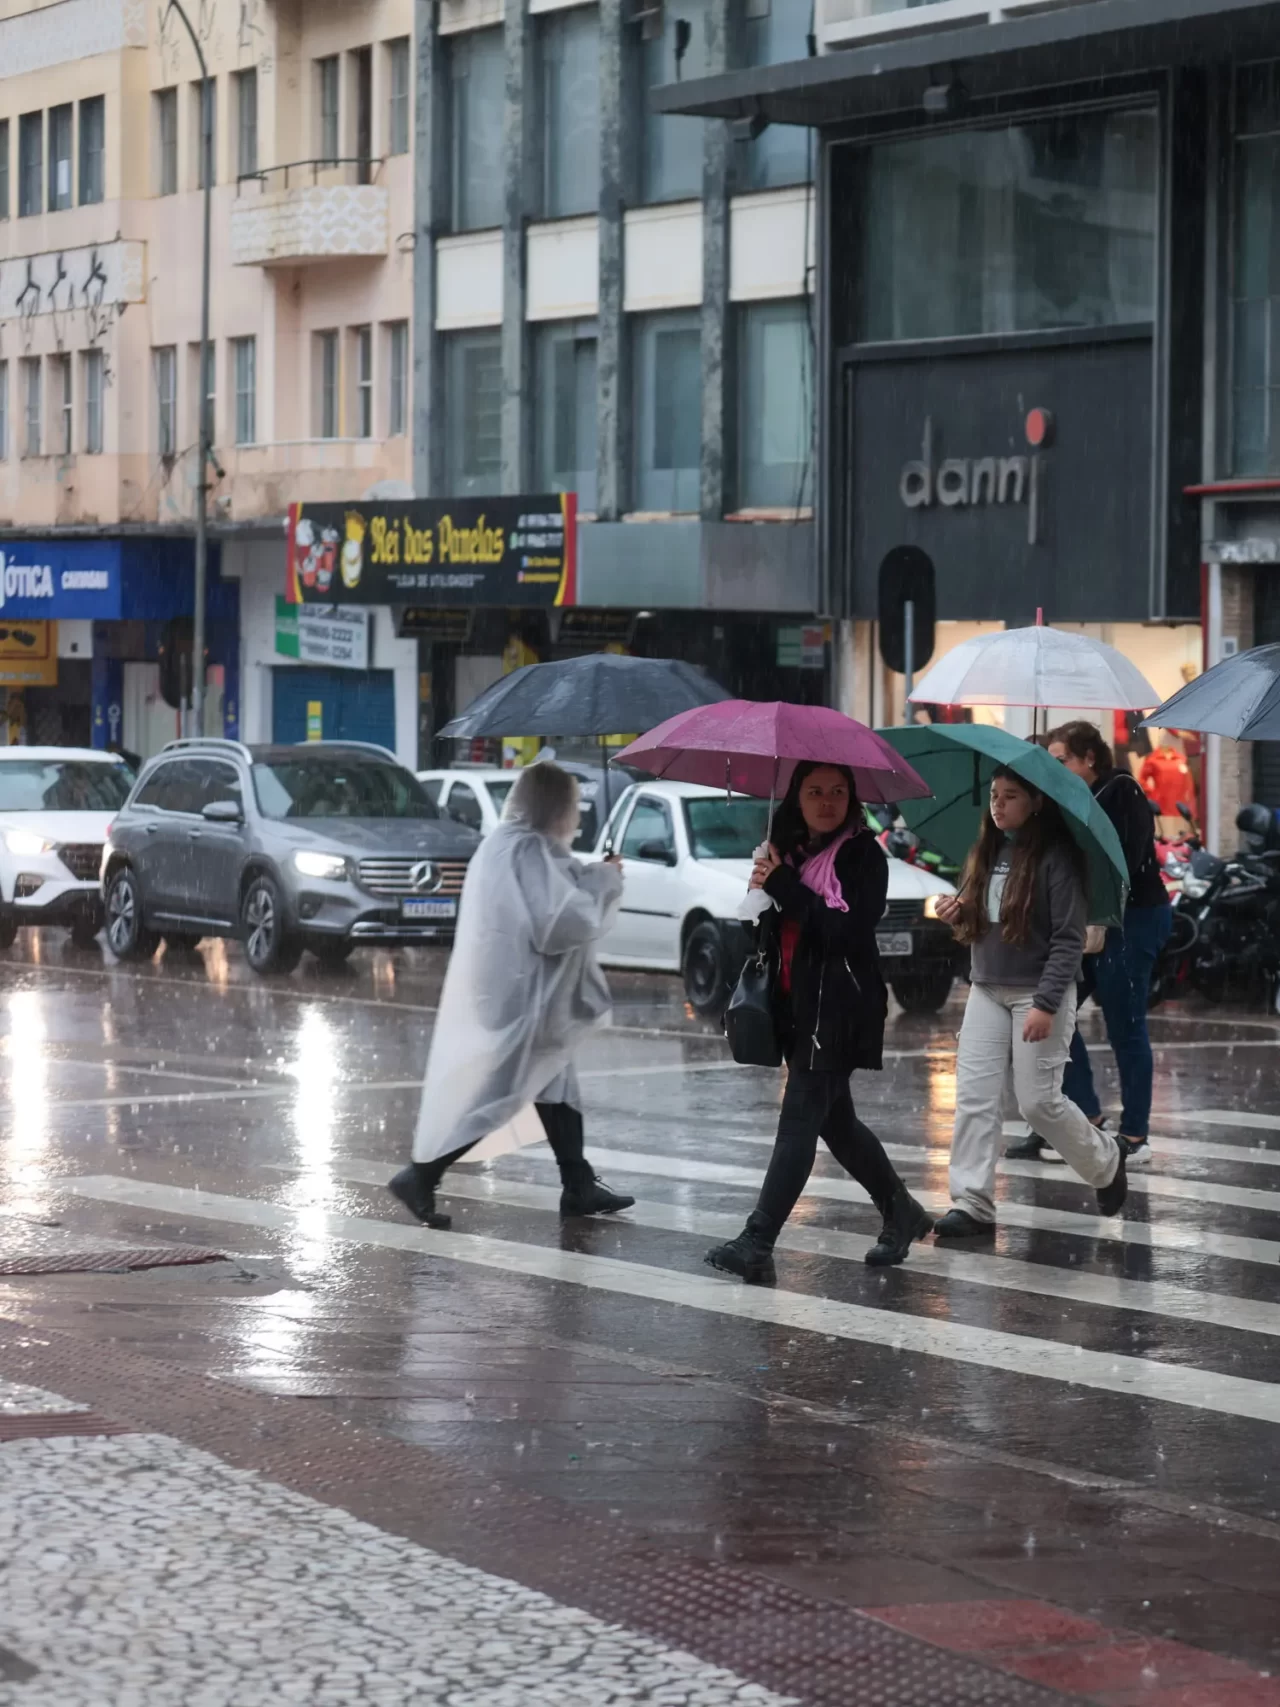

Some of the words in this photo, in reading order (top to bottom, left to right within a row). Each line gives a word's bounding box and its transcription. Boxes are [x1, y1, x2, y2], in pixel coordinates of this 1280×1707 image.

[371, 515, 399, 564] Rei
[438, 512, 504, 564] Panelas
[5, 555, 54, 598] ÓTICA
